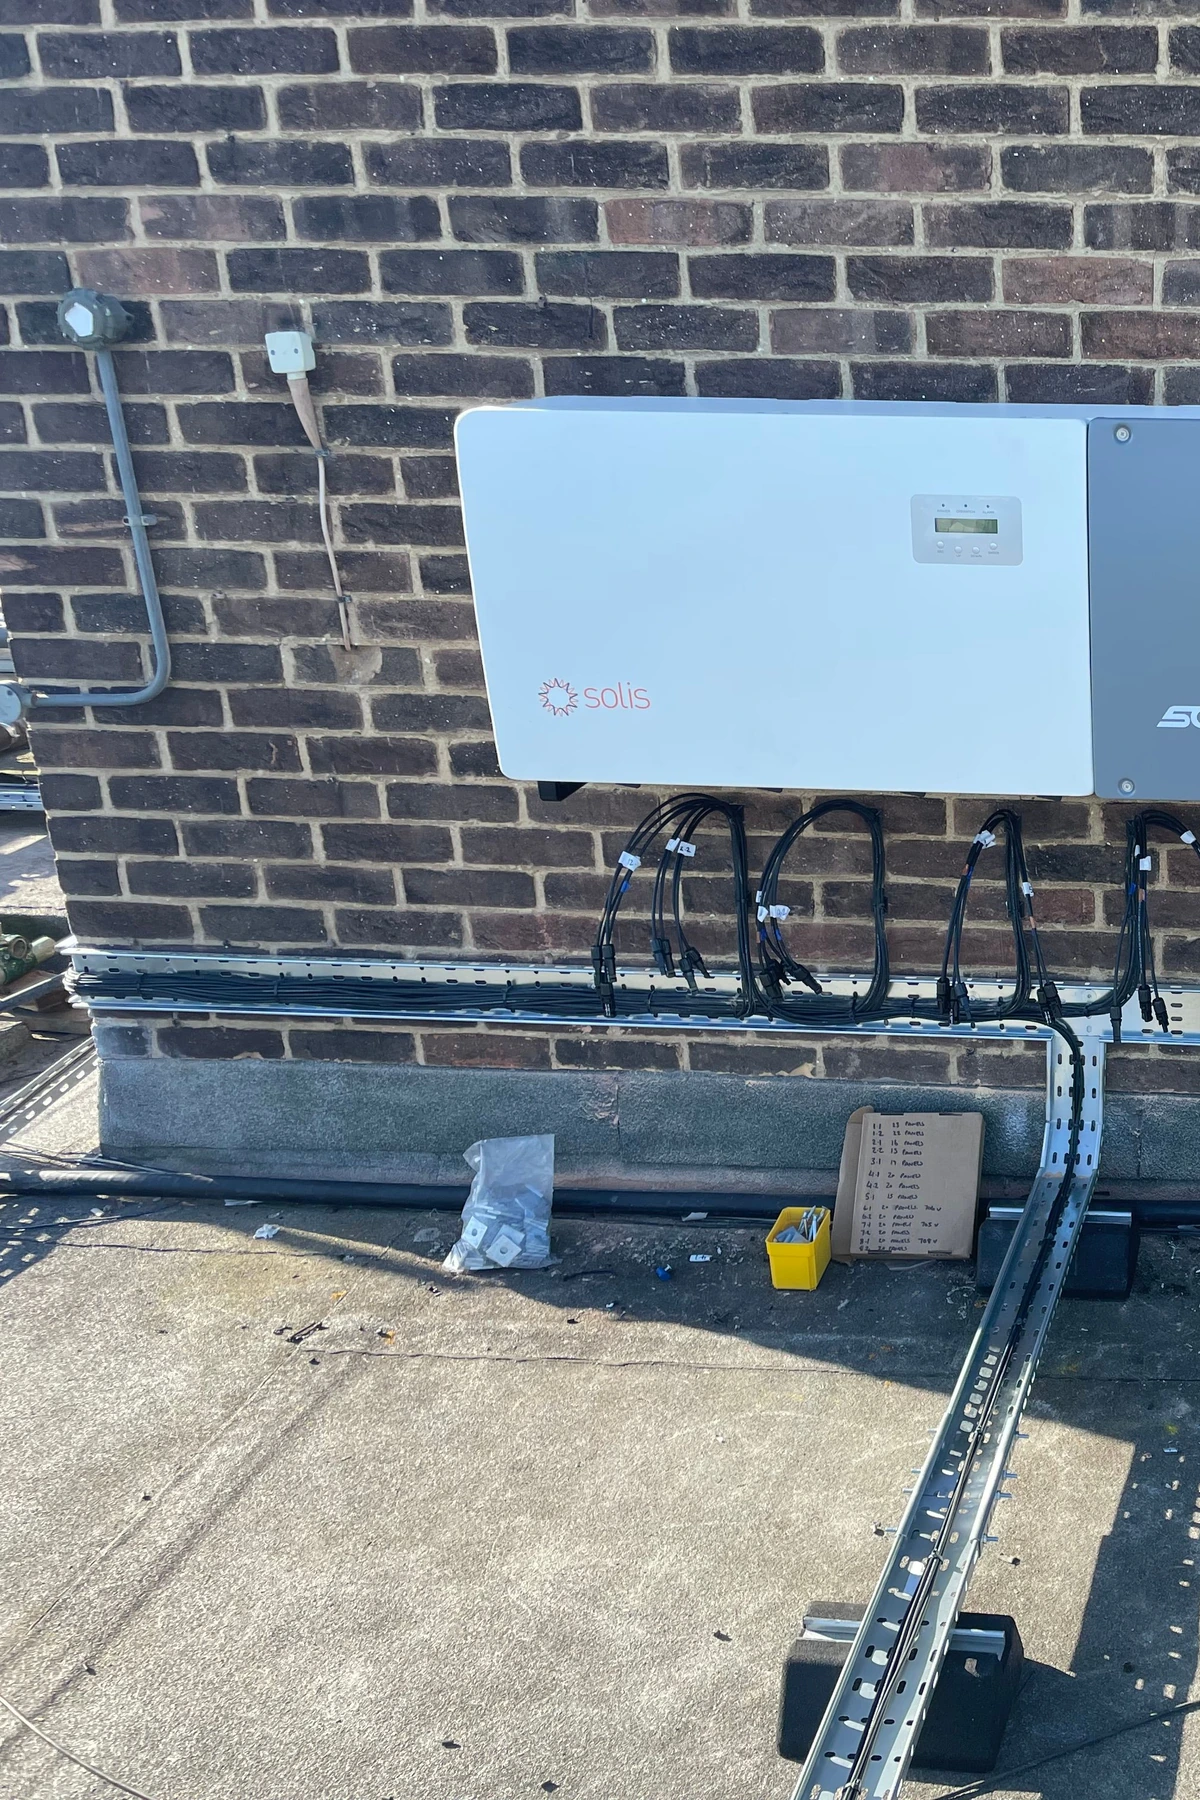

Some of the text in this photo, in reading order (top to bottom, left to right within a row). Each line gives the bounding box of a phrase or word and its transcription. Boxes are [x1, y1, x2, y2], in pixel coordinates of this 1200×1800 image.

[584, 682, 651, 710] solis
[870, 1157, 881, 1165] 3.1
[866, 1181, 879, 1189] 4.2
